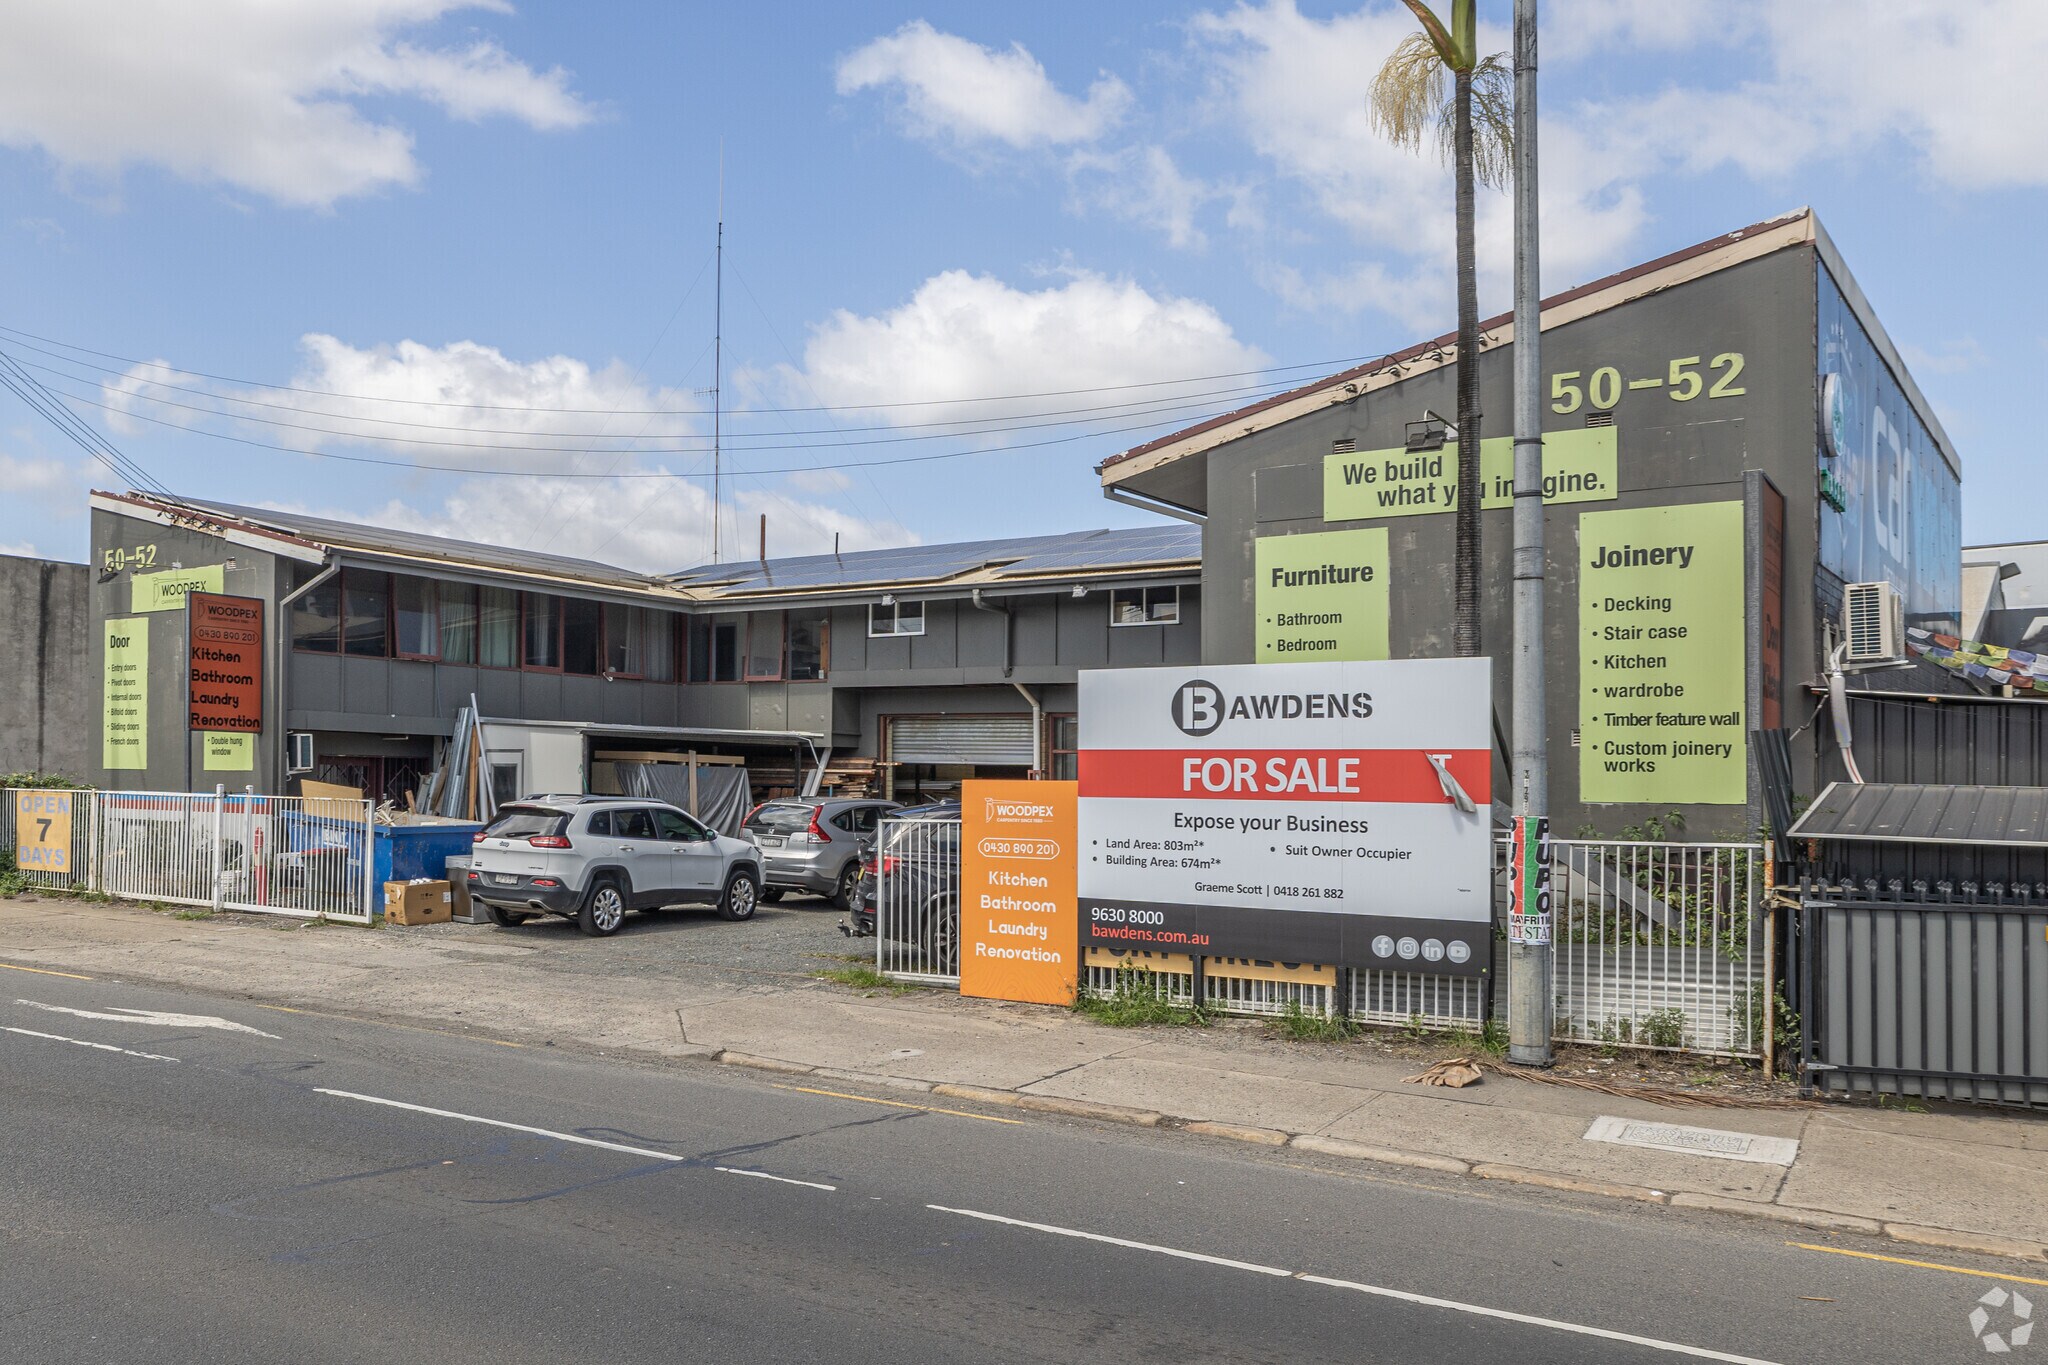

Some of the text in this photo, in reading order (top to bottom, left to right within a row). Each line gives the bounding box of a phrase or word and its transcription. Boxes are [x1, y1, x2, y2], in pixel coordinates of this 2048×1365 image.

[1551, 352, 1746, 415] 50-52
[1343, 455, 1443, 485] We build
[1377, 481, 1436, 508] what
[1495, 469, 1606, 499] igine.
[1591, 544, 1694, 569] Joinery
[1272, 564, 1374, 588] Furniture
[208, 606, 257, 619] WOODPEX
[1604, 596, 1671, 615] Decking
[1277, 611, 1342, 627] Bathroom
[199, 629, 221, 638] 0430
[242, 633, 255, 641] 201
[1604, 625, 1687, 640] Stair case
[110, 635, 130, 648] Door
[1277, 638, 1337, 653] Bedroom
[192, 647, 240, 662] Kitchen
[1604, 654, 1667, 669] Kitchen
[112, 664, 122, 672] Entry
[192, 669, 252, 685] Bathroom
[1604, 683, 1684, 698] wardrobe
[192, 691, 238, 708] Laundry
[1171, 679, 1373, 737] BAWDENS
[111, 723, 125, 732] Sliding
[192, 713, 260, 728] Renovation
[1604, 712, 1740, 727] Timber feature wall
[211, 737, 242, 746] Double hung
[1604, 742, 1731, 759] Custom joinery
[1604, 758, 1656, 773] works
[1183, 758, 1360, 794] FOR SALE
[21, 796, 69, 814] OPEN
[997, 806, 1053, 816] WOODPEX
[37, 818, 52, 842] 7
[1174, 812, 1368, 834] Expose your Business
[984, 842, 1054, 855] 0430 890 201
[1106, 839, 1130, 849] Land
[1133, 839, 1161, 850] Area:
[20, 846, 64, 866] DAYS
[1106, 855, 1146, 868] Building
[1150, 856, 1178, 868] Area:
[1286, 845, 1412, 862] Suit Owner Occupier
[989, 871, 1048, 887] Kitchen
[1195, 881, 1343, 899] Graeme Scott 0418 261 882
[981, 895, 1056, 913] Bathroom
[1091, 908, 1163, 925] 9630 8000
[989, 920, 1047, 940] Laundry
[1092, 924, 1209, 945] bawdens.com.au
[976, 943, 1061, 963] Renovation
